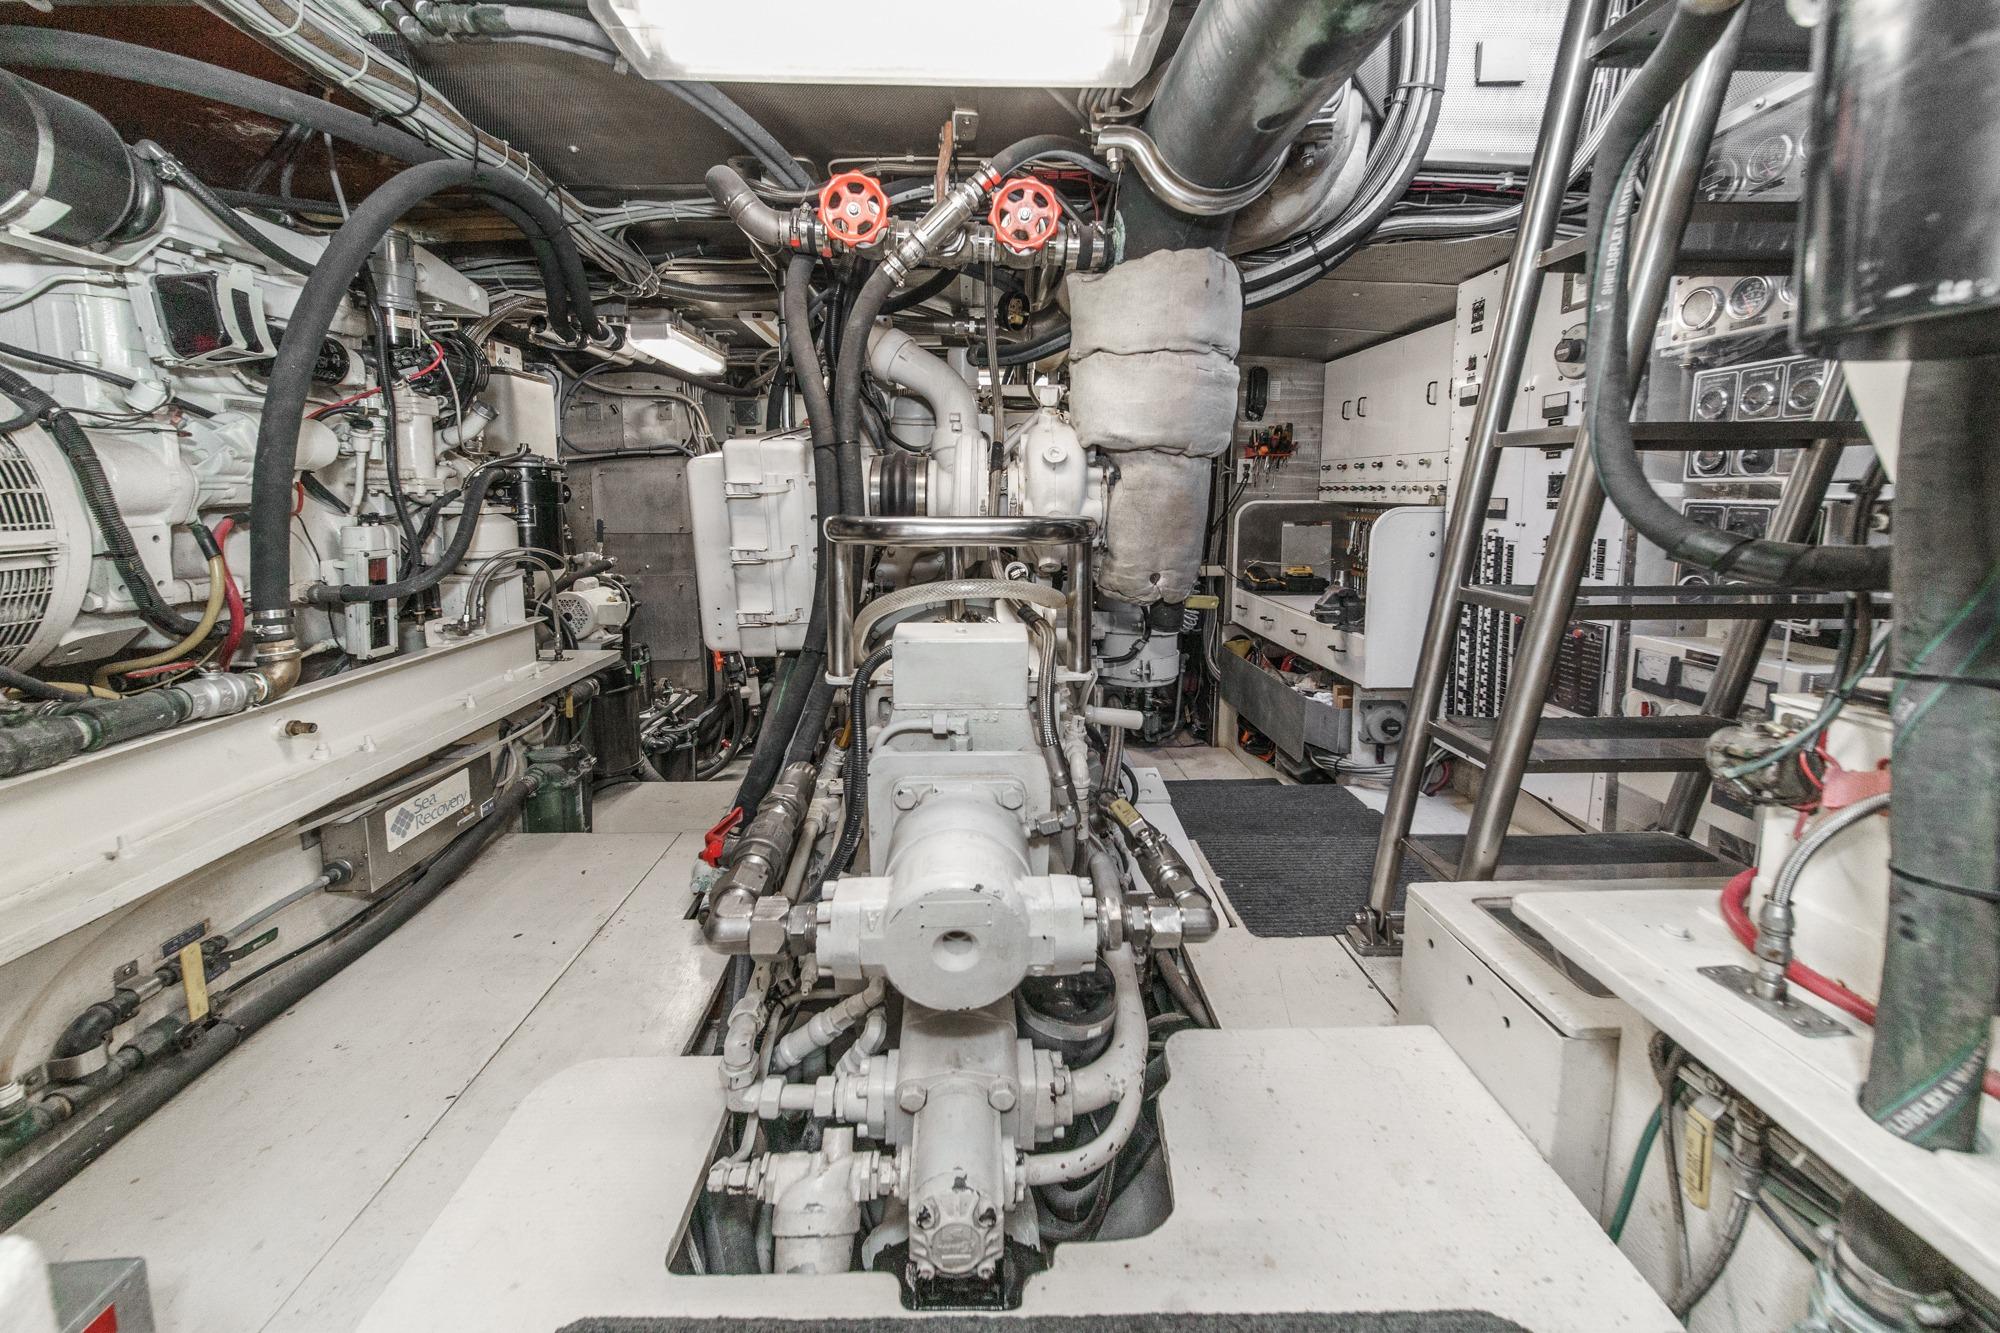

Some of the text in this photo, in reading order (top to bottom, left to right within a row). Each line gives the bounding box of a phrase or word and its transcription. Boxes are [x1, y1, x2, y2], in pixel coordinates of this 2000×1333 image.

[1600, 226, 1625, 296] SHIELDSFLEX
[414, 793, 437, 815] Sea
[414, 791, 467, 830] Recovery
